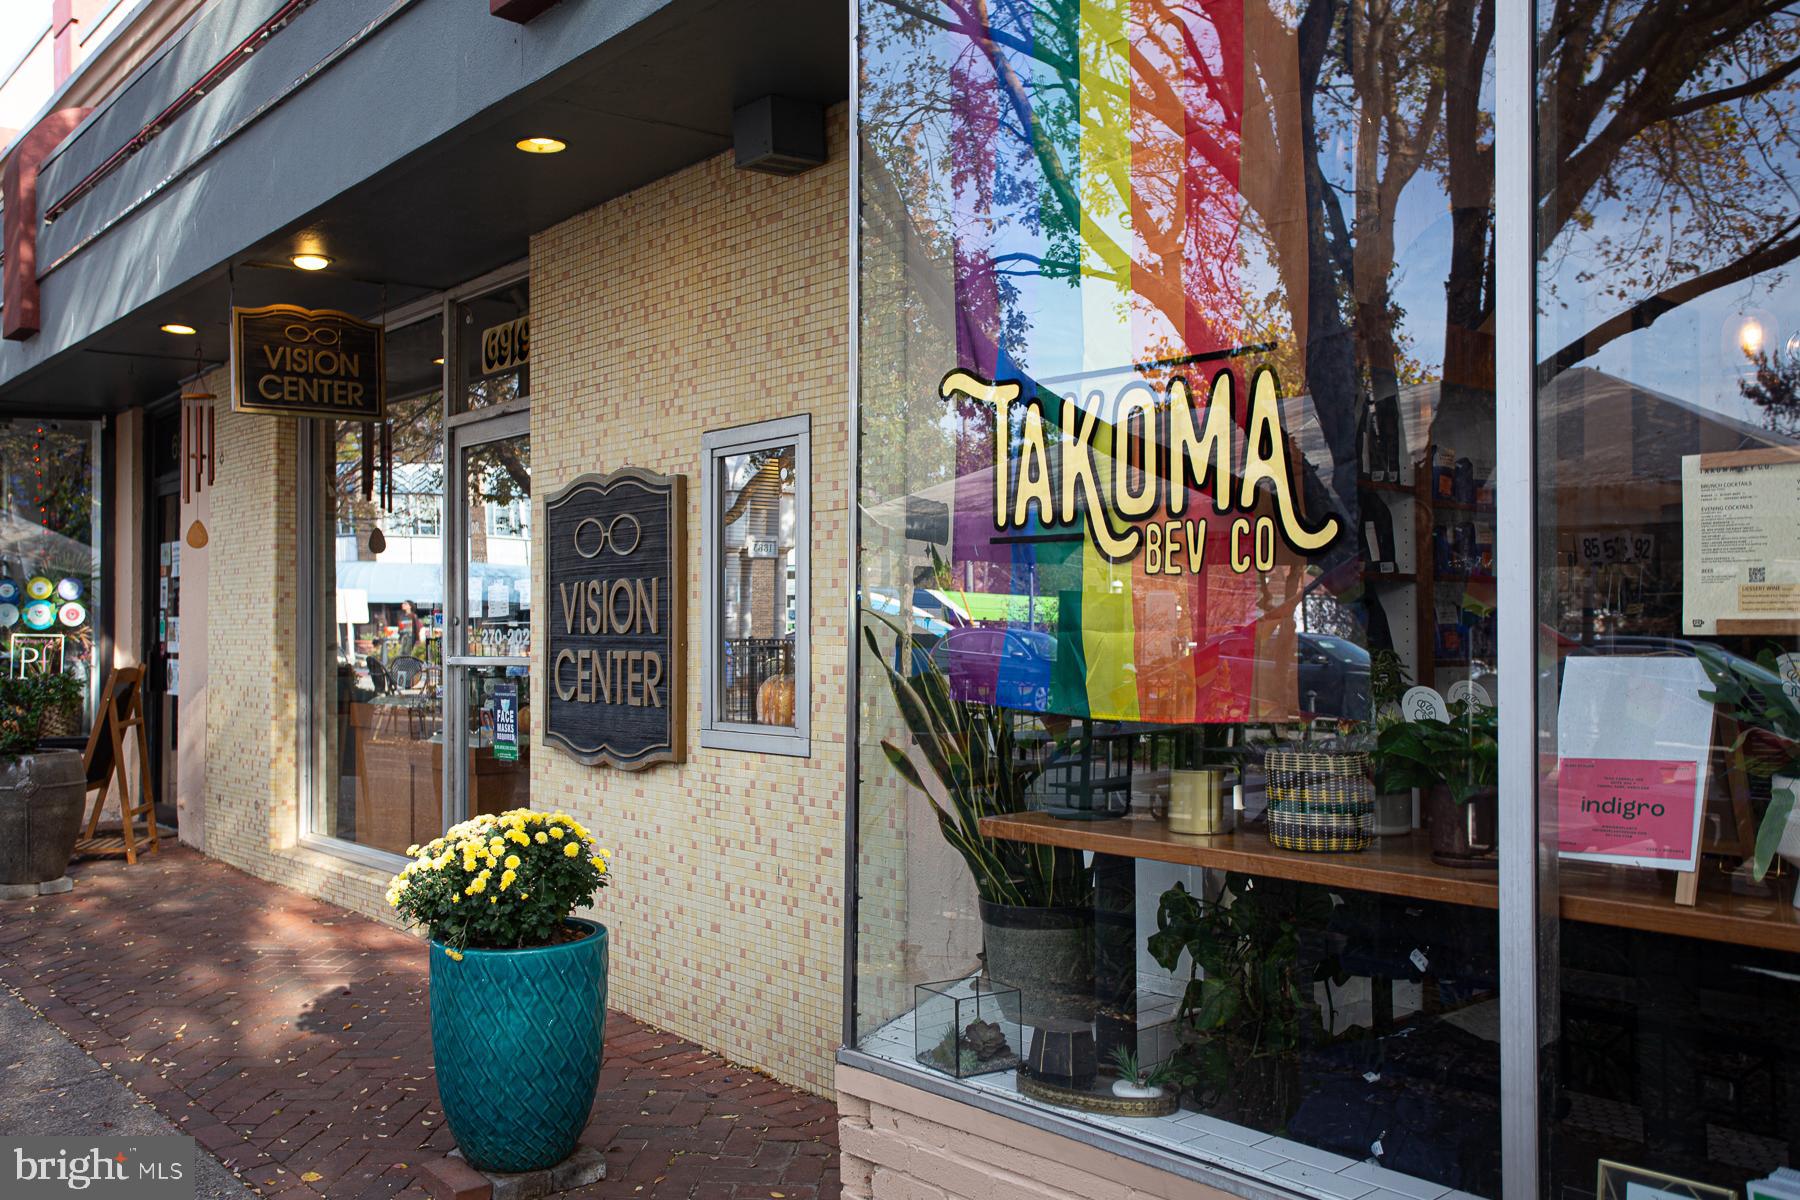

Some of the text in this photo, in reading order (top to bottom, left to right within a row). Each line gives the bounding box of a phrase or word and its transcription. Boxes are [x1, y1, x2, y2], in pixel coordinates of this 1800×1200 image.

[485, 317, 530, 369] 6919
[263, 344, 360, 378] VISION
[258, 374, 364, 406] CENTER
[939, 364, 1343, 563] TAKOMA
[1725, 503, 1753, 511] COCKTAILS
[1144, 515, 1278, 575] BEV CO
[560, 577, 659, 634] VISION
[555, 648, 663, 707] CENTER
[497, 709, 514, 723] FACE
[497, 723, 514, 734] MASKS
[1581, 796, 1665, 820] indigro
